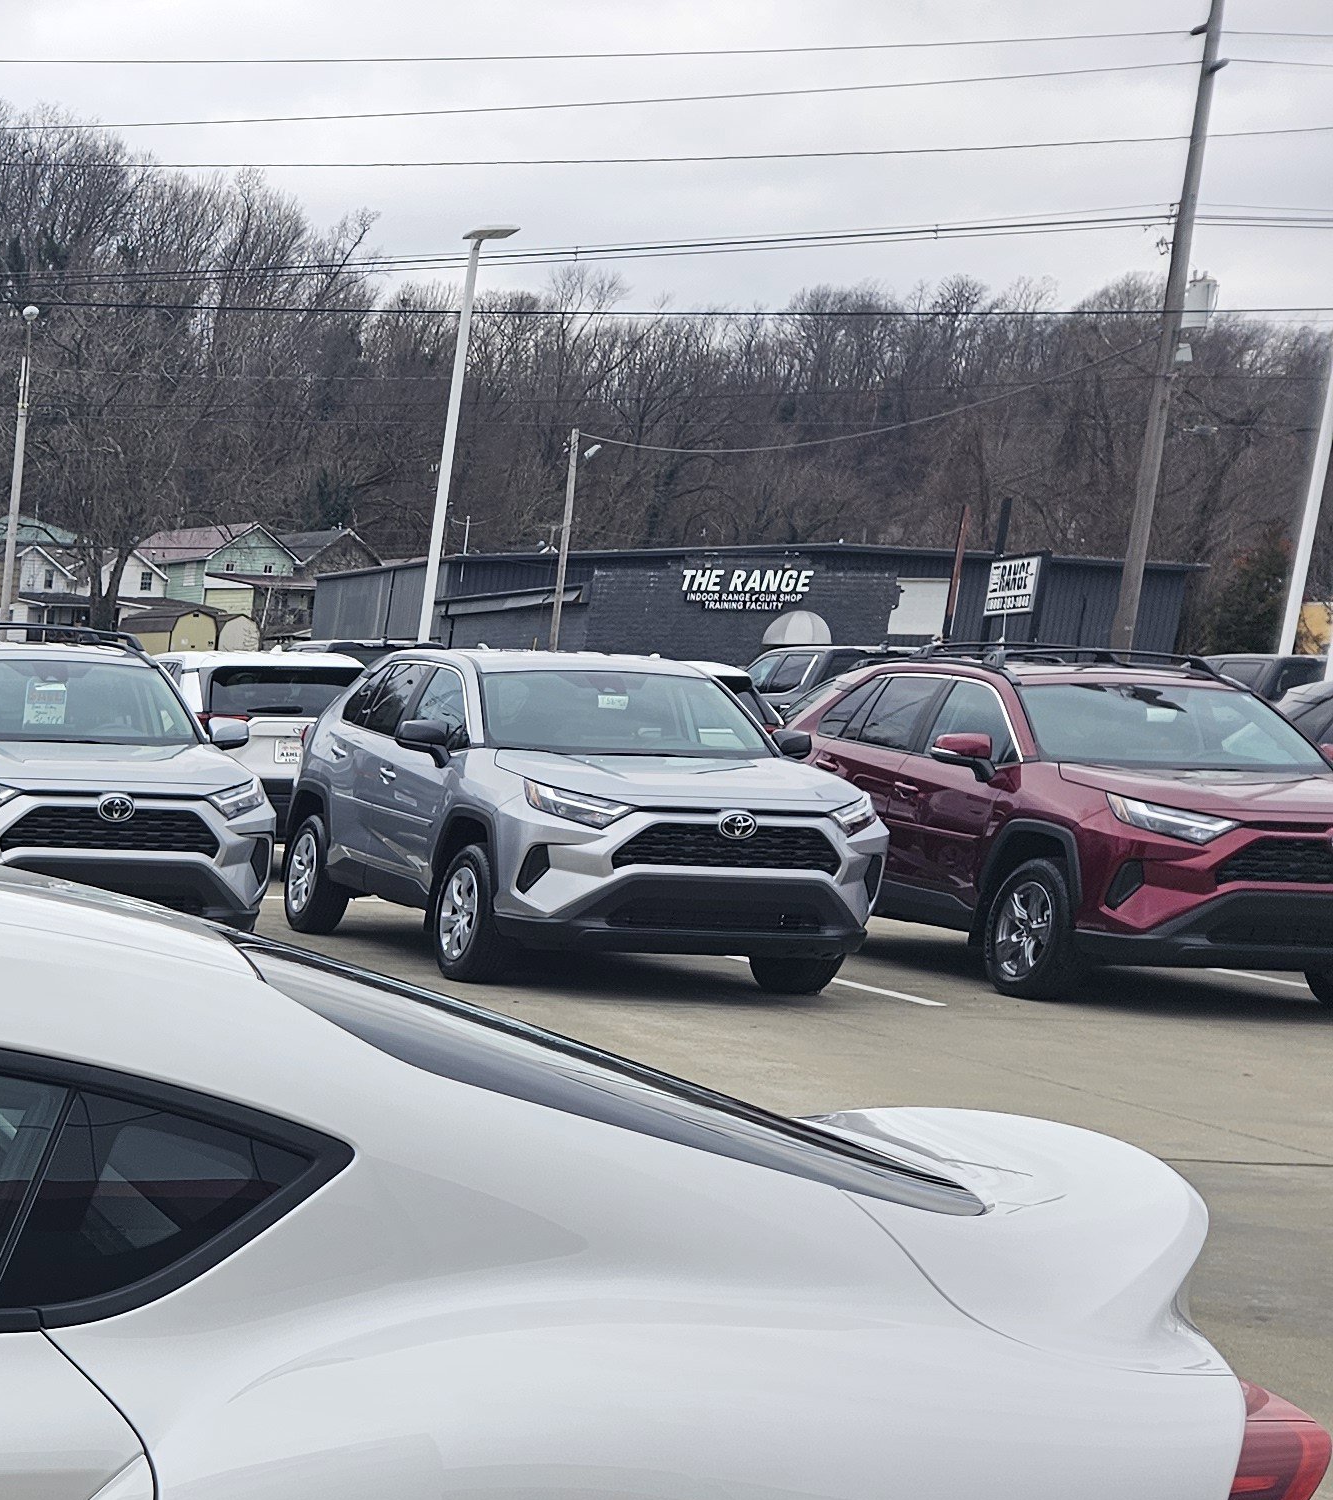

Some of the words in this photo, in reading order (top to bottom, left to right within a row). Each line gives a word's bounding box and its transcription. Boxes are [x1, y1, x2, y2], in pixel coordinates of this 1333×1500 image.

[681, 569, 725, 592] THE
[728, 569, 815, 593] RANGE
[686, 592, 720, 601] INDOOR
[721, 593, 751, 601] RANGE
[758, 594, 778, 602] GUN
[779, 594, 803, 603] SHOP
[704, 601, 744, 610] TRAINING
[745, 601, 783, 610] FACILITY
